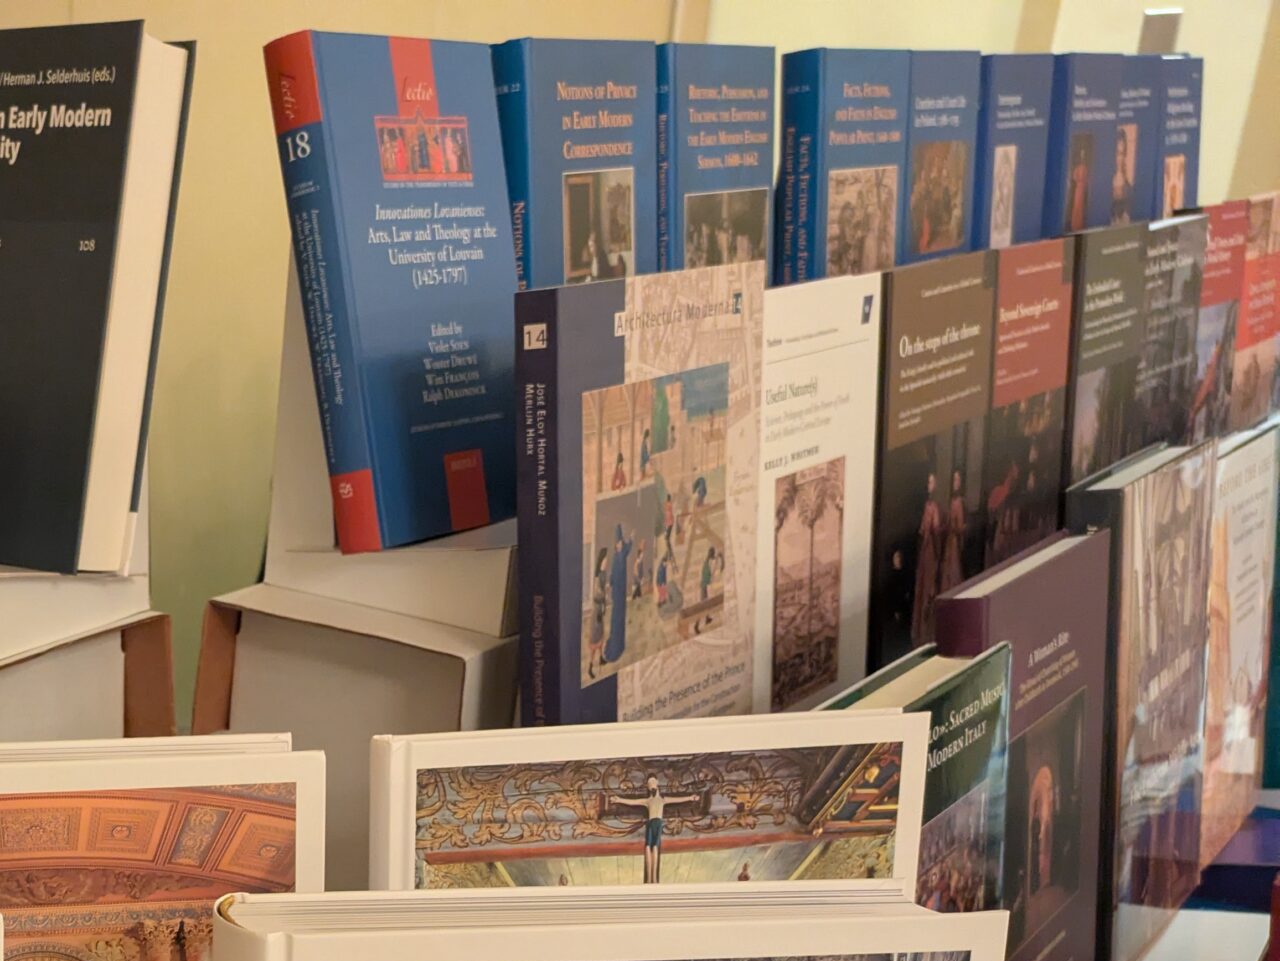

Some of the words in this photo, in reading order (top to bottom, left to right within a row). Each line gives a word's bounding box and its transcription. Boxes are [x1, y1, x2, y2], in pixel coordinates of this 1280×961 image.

[37, 71, 44, 84] J.
[46, 68, 90, 84] Selderhuis
[91, 67, 115, 84] (eds.)
[8, 104, 47, 135] Early
[49, 103, 112, 128] Modern
[286, 131, 312, 163] 18
[375, 204, 432, 221] Innovationes
[434, 202, 486, 219] Lovanienses:
[368, 227, 391, 244] Arts,
[392, 226, 412, 242] Law
[415, 224, 431, 241] and
[432, 223, 471, 244] Theology
[473, 225, 482, 238] at
[483, 222, 497, 238] the
[388, 248, 436, 267] University
[437, 245, 449, 262] of
[449, 246, 484, 262] Louvain
[412, 266, 468, 289] (1425-1797)
[525, 329, 547, 347] 14
